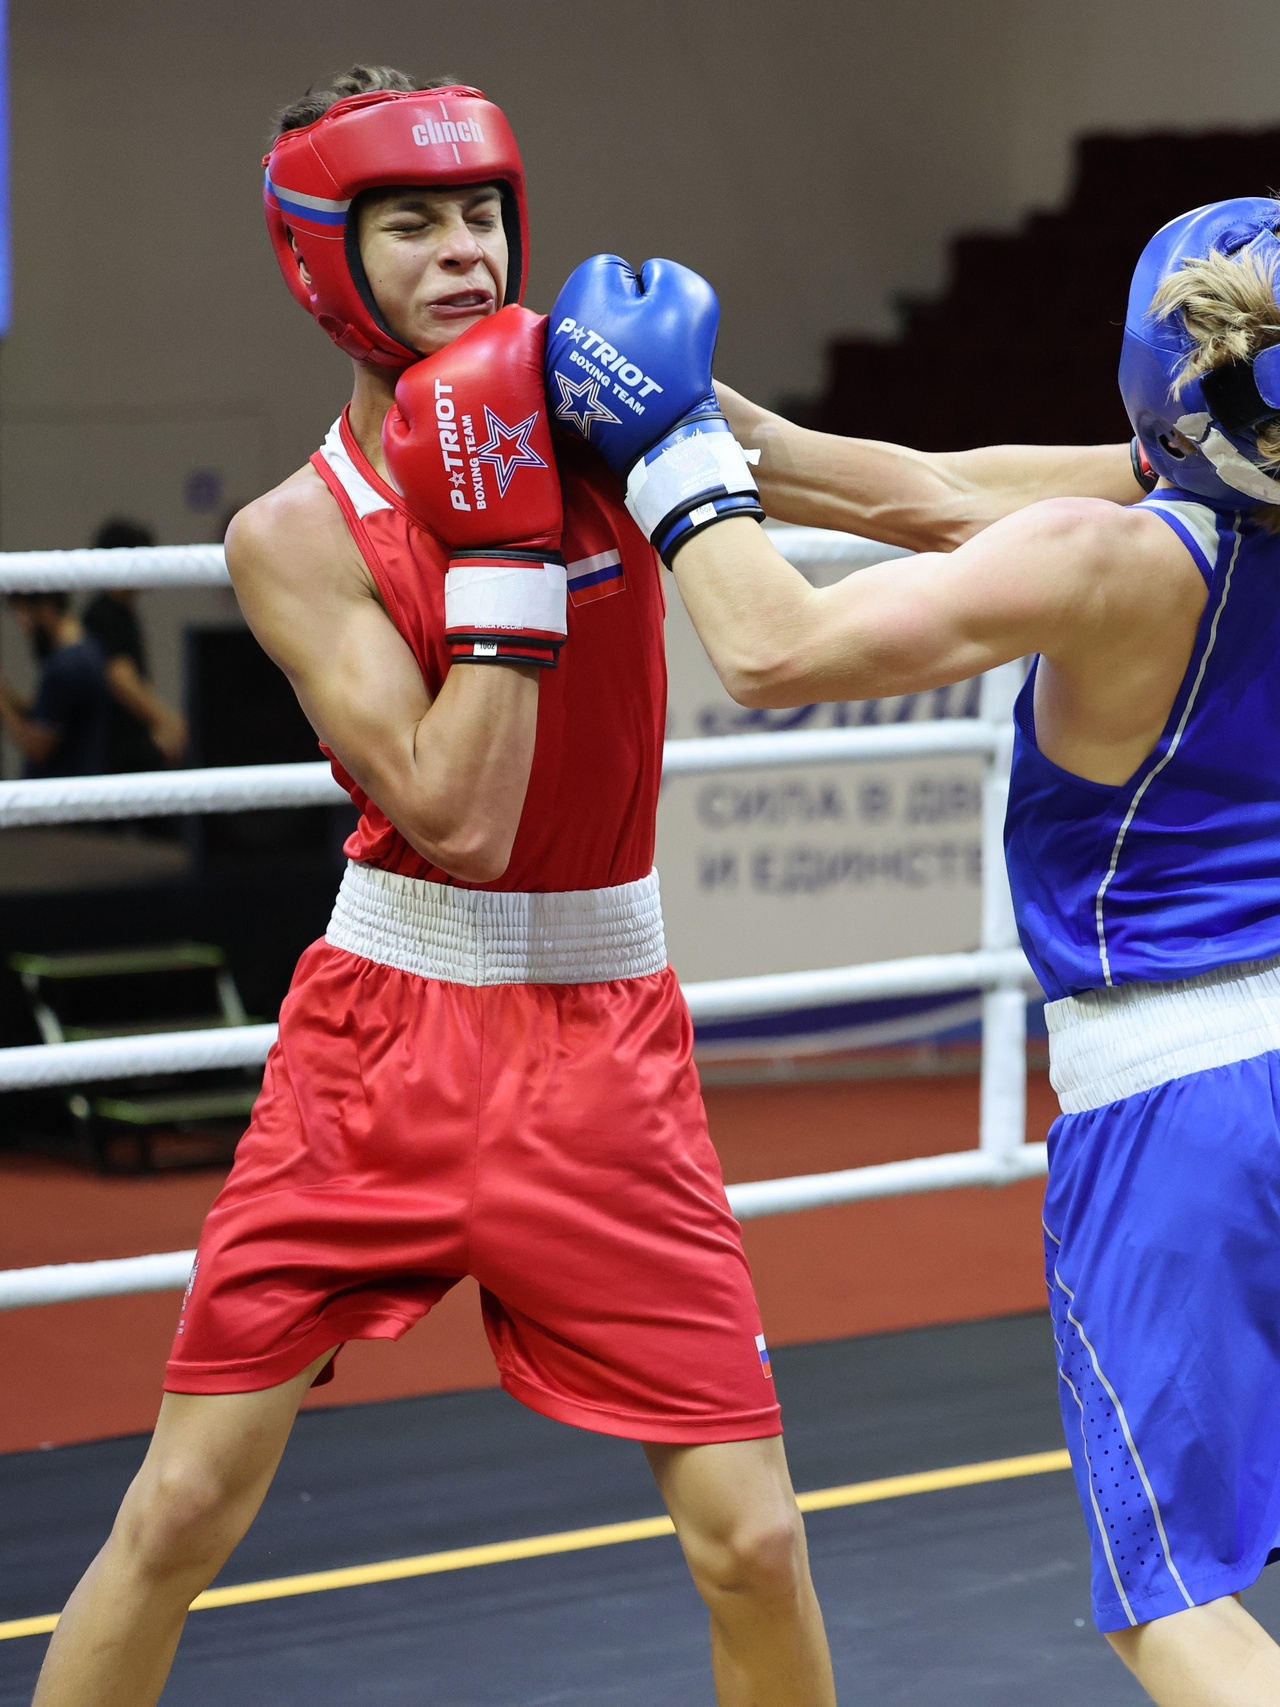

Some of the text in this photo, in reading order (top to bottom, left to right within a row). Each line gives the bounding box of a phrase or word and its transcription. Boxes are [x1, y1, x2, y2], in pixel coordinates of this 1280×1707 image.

[412, 117, 485, 147] clinch
[568, 350, 646, 416] BOXING TEAM
[461, 414, 487, 510] BOXING TEAM
[699, 781, 846, 830] СИЛА
[700, 853, 738, 893] И
